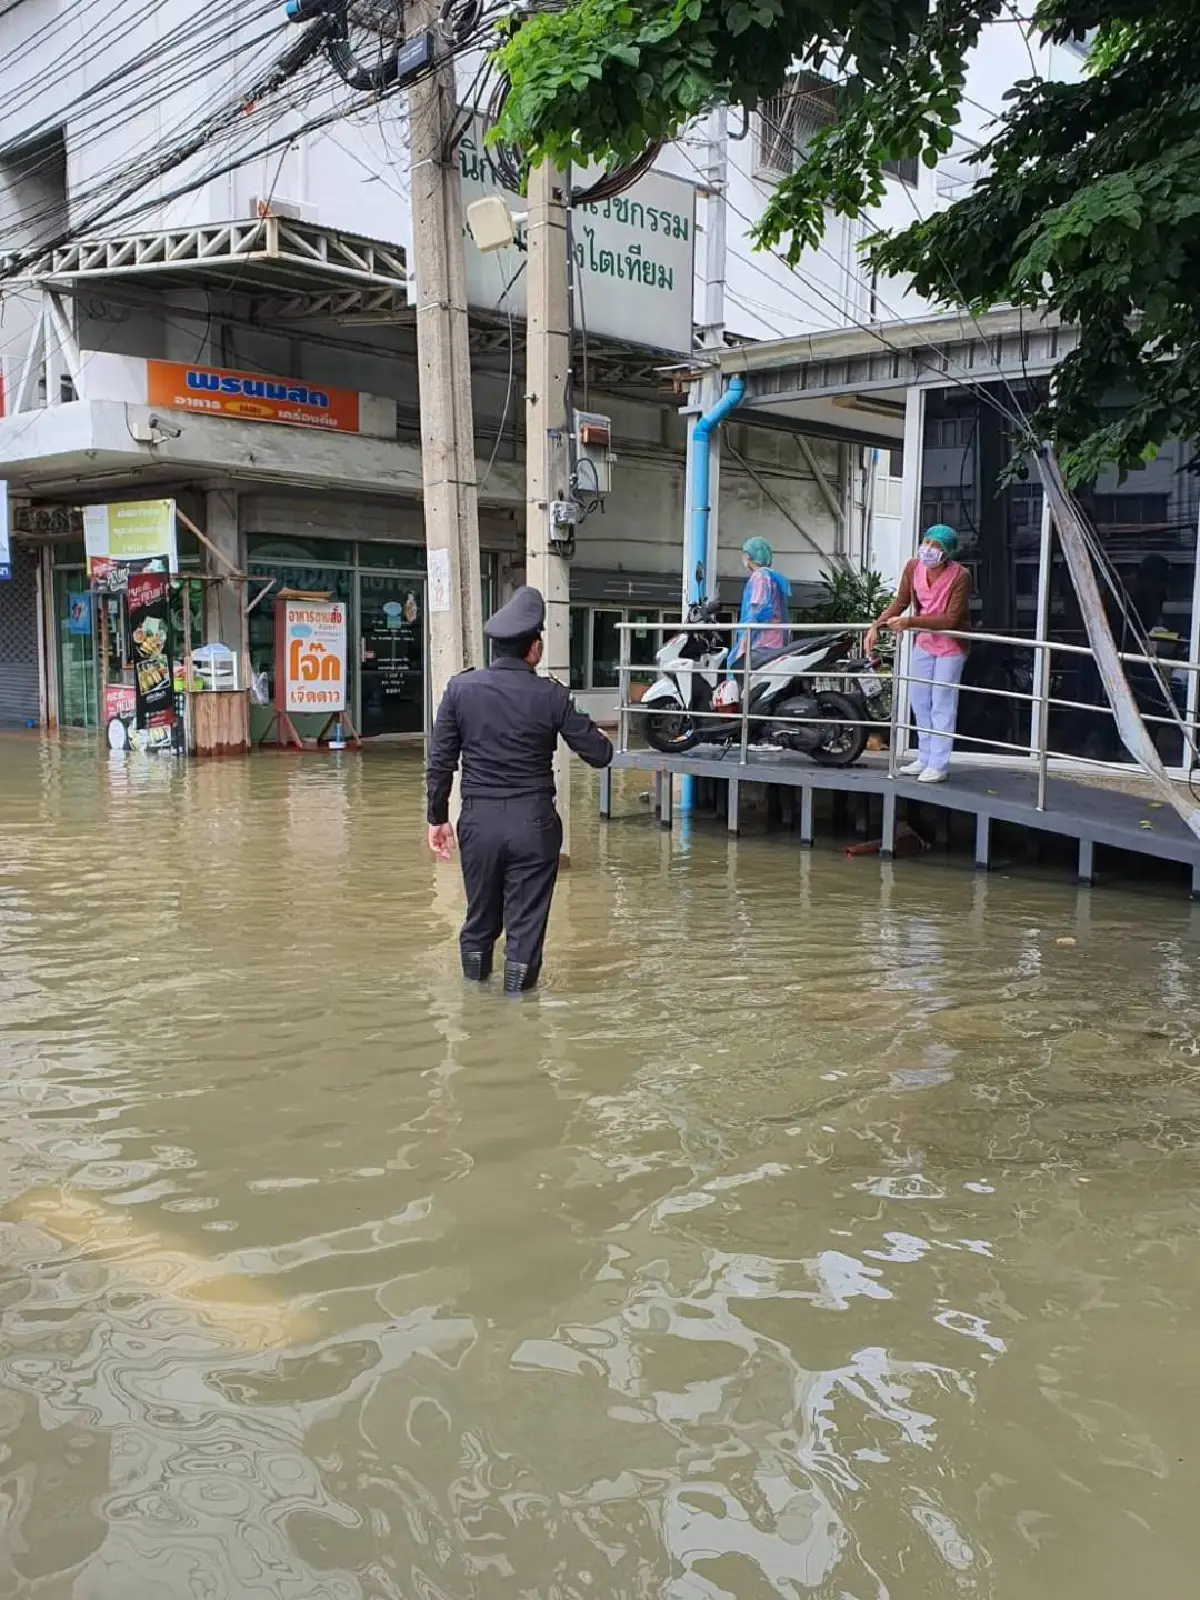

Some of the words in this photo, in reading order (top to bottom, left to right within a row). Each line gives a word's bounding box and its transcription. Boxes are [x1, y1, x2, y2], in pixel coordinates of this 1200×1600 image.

[186, 370, 329, 408] พรนมสด
[174, 395, 222, 410] อาหาร
[277, 408, 338, 427] เครื่องดื่ม
[289, 639, 341, 681] โจ๊ก
